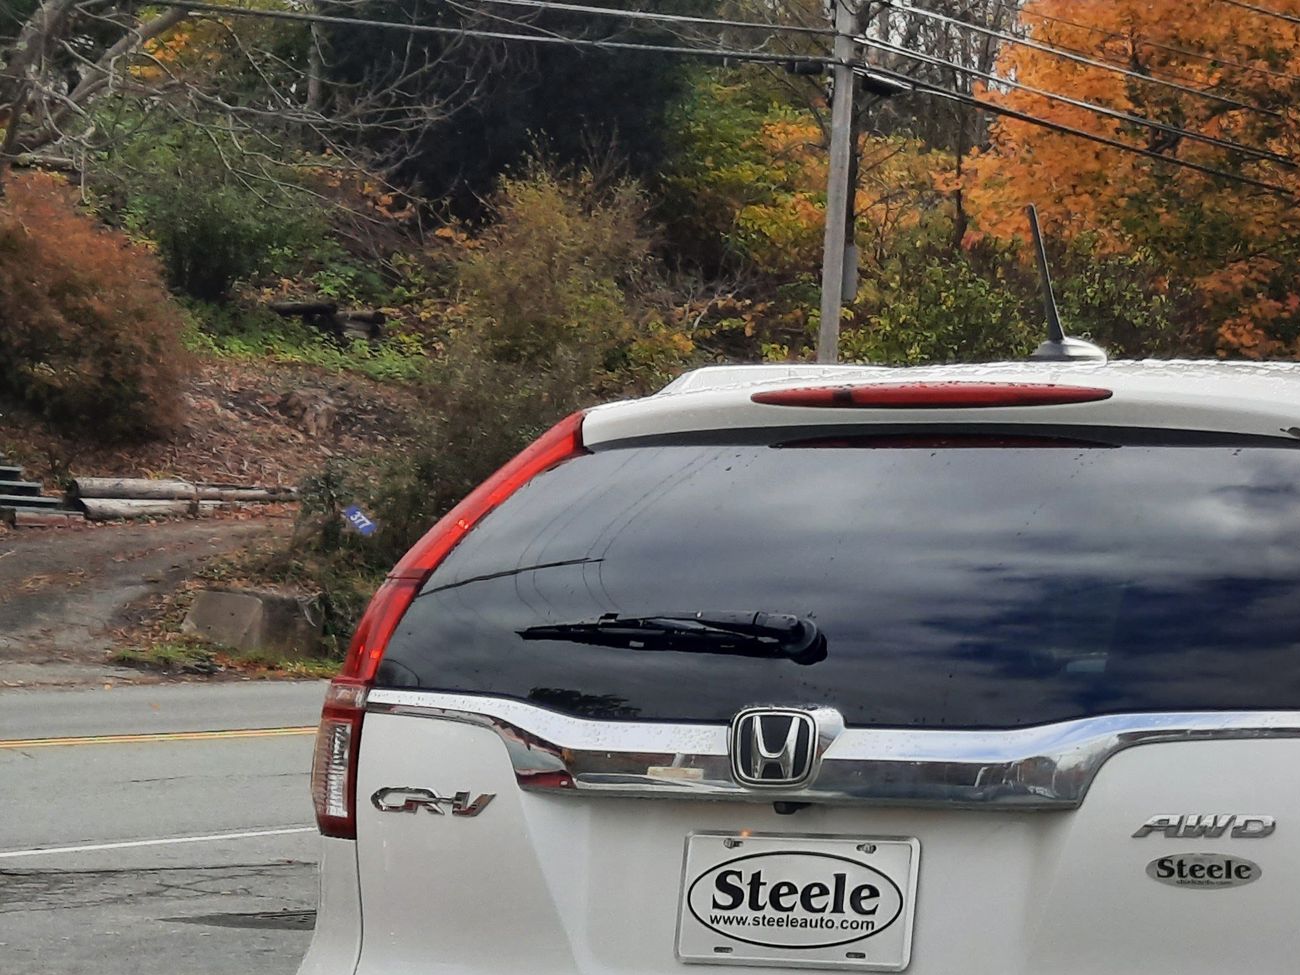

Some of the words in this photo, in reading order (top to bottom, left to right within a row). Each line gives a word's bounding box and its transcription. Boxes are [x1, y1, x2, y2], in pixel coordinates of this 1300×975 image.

[350, 511, 371, 528] 377
[371, 787, 497, 817] CR-V
[1131, 814, 1276, 838] AWD
[1157, 858, 1252, 879] Steele
[712, 869, 880, 916] Steele
[709, 914, 875, 931] www.steeleauto.com
